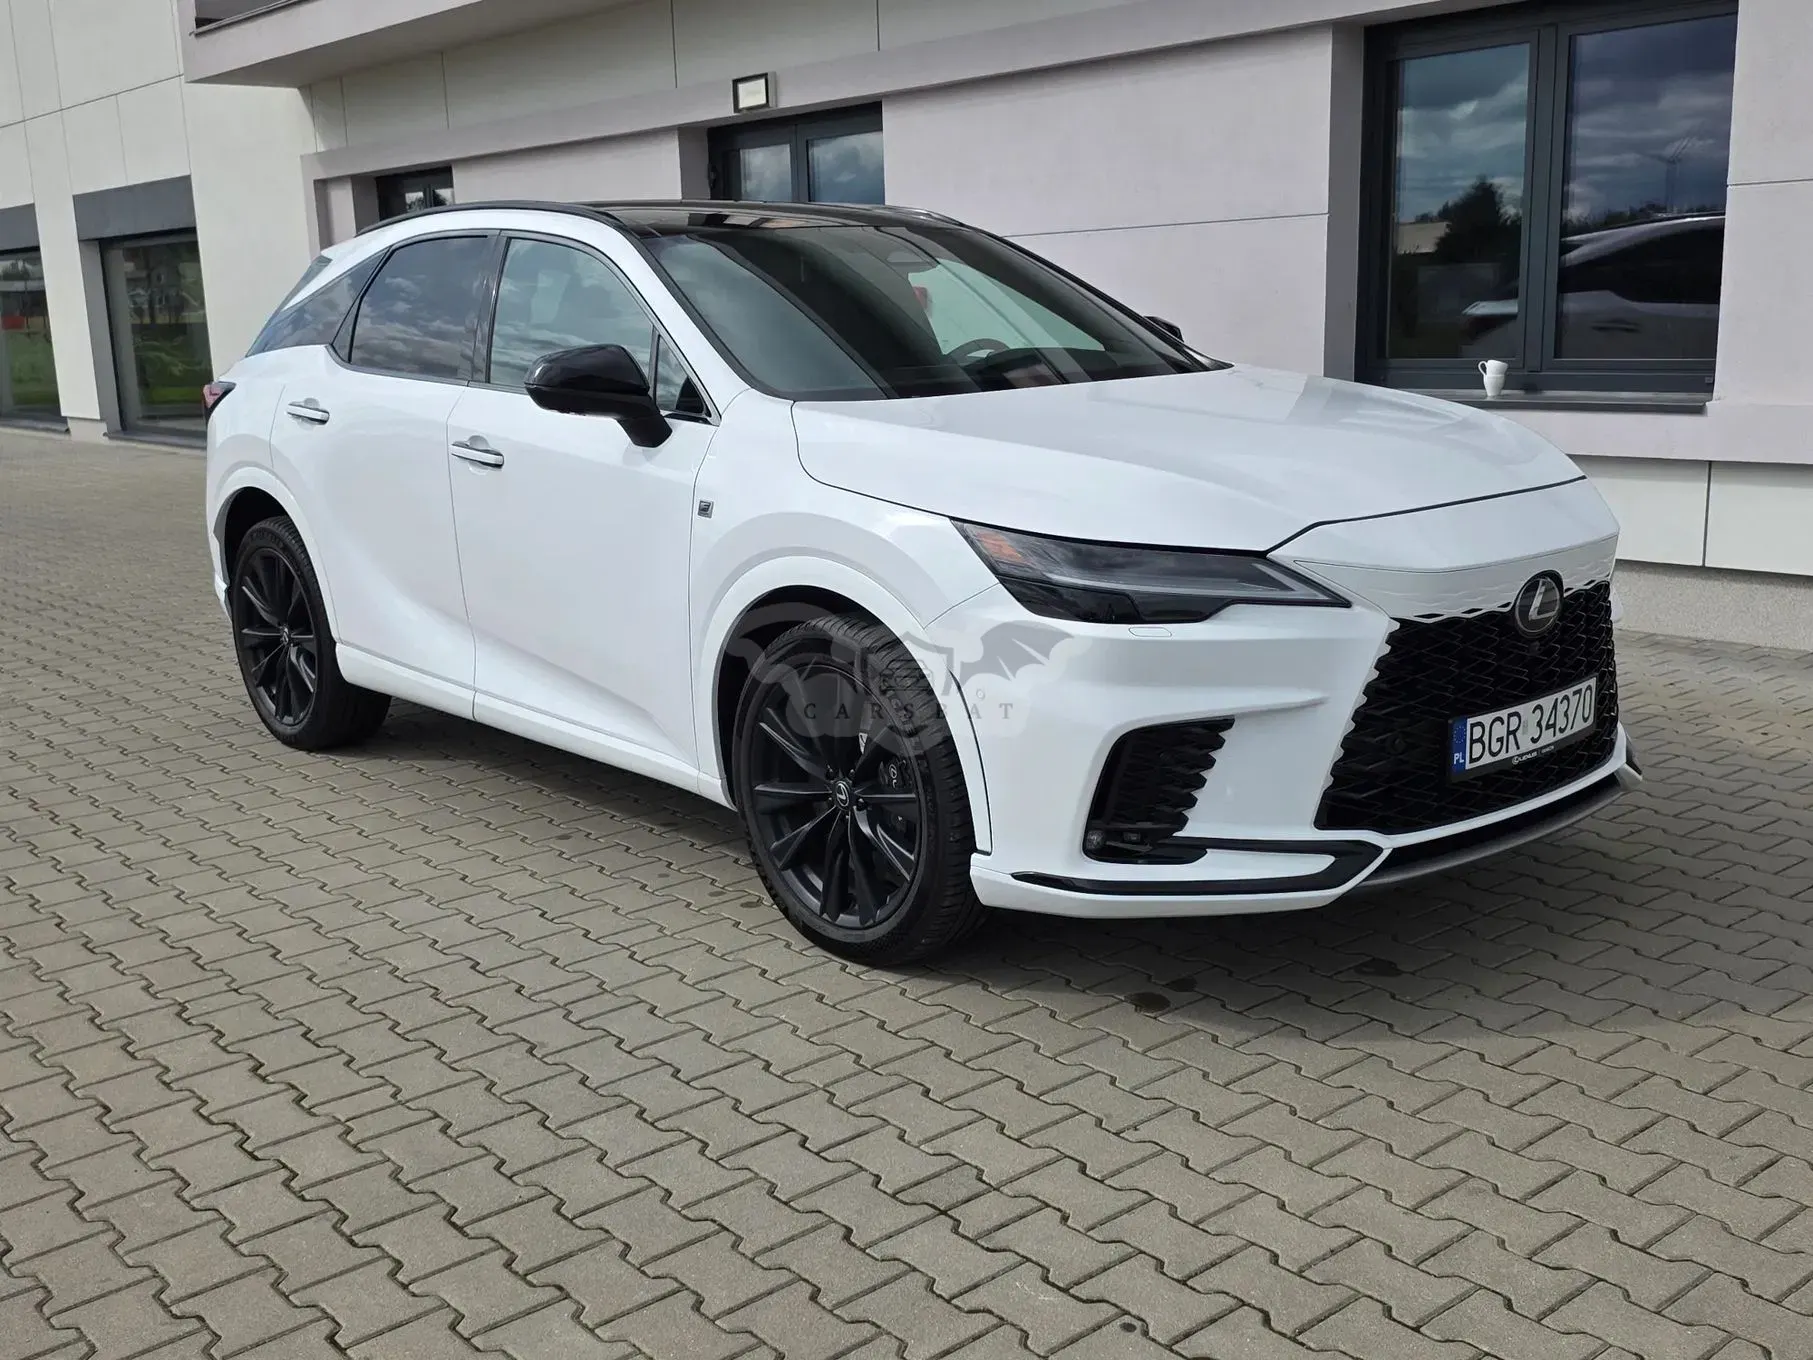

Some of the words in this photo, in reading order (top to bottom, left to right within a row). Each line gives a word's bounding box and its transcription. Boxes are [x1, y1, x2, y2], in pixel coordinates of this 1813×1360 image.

[1468, 711, 1521, 764] BGR
[1530, 684, 1593, 744] 34370
[1453, 751, 1465, 765] PL
